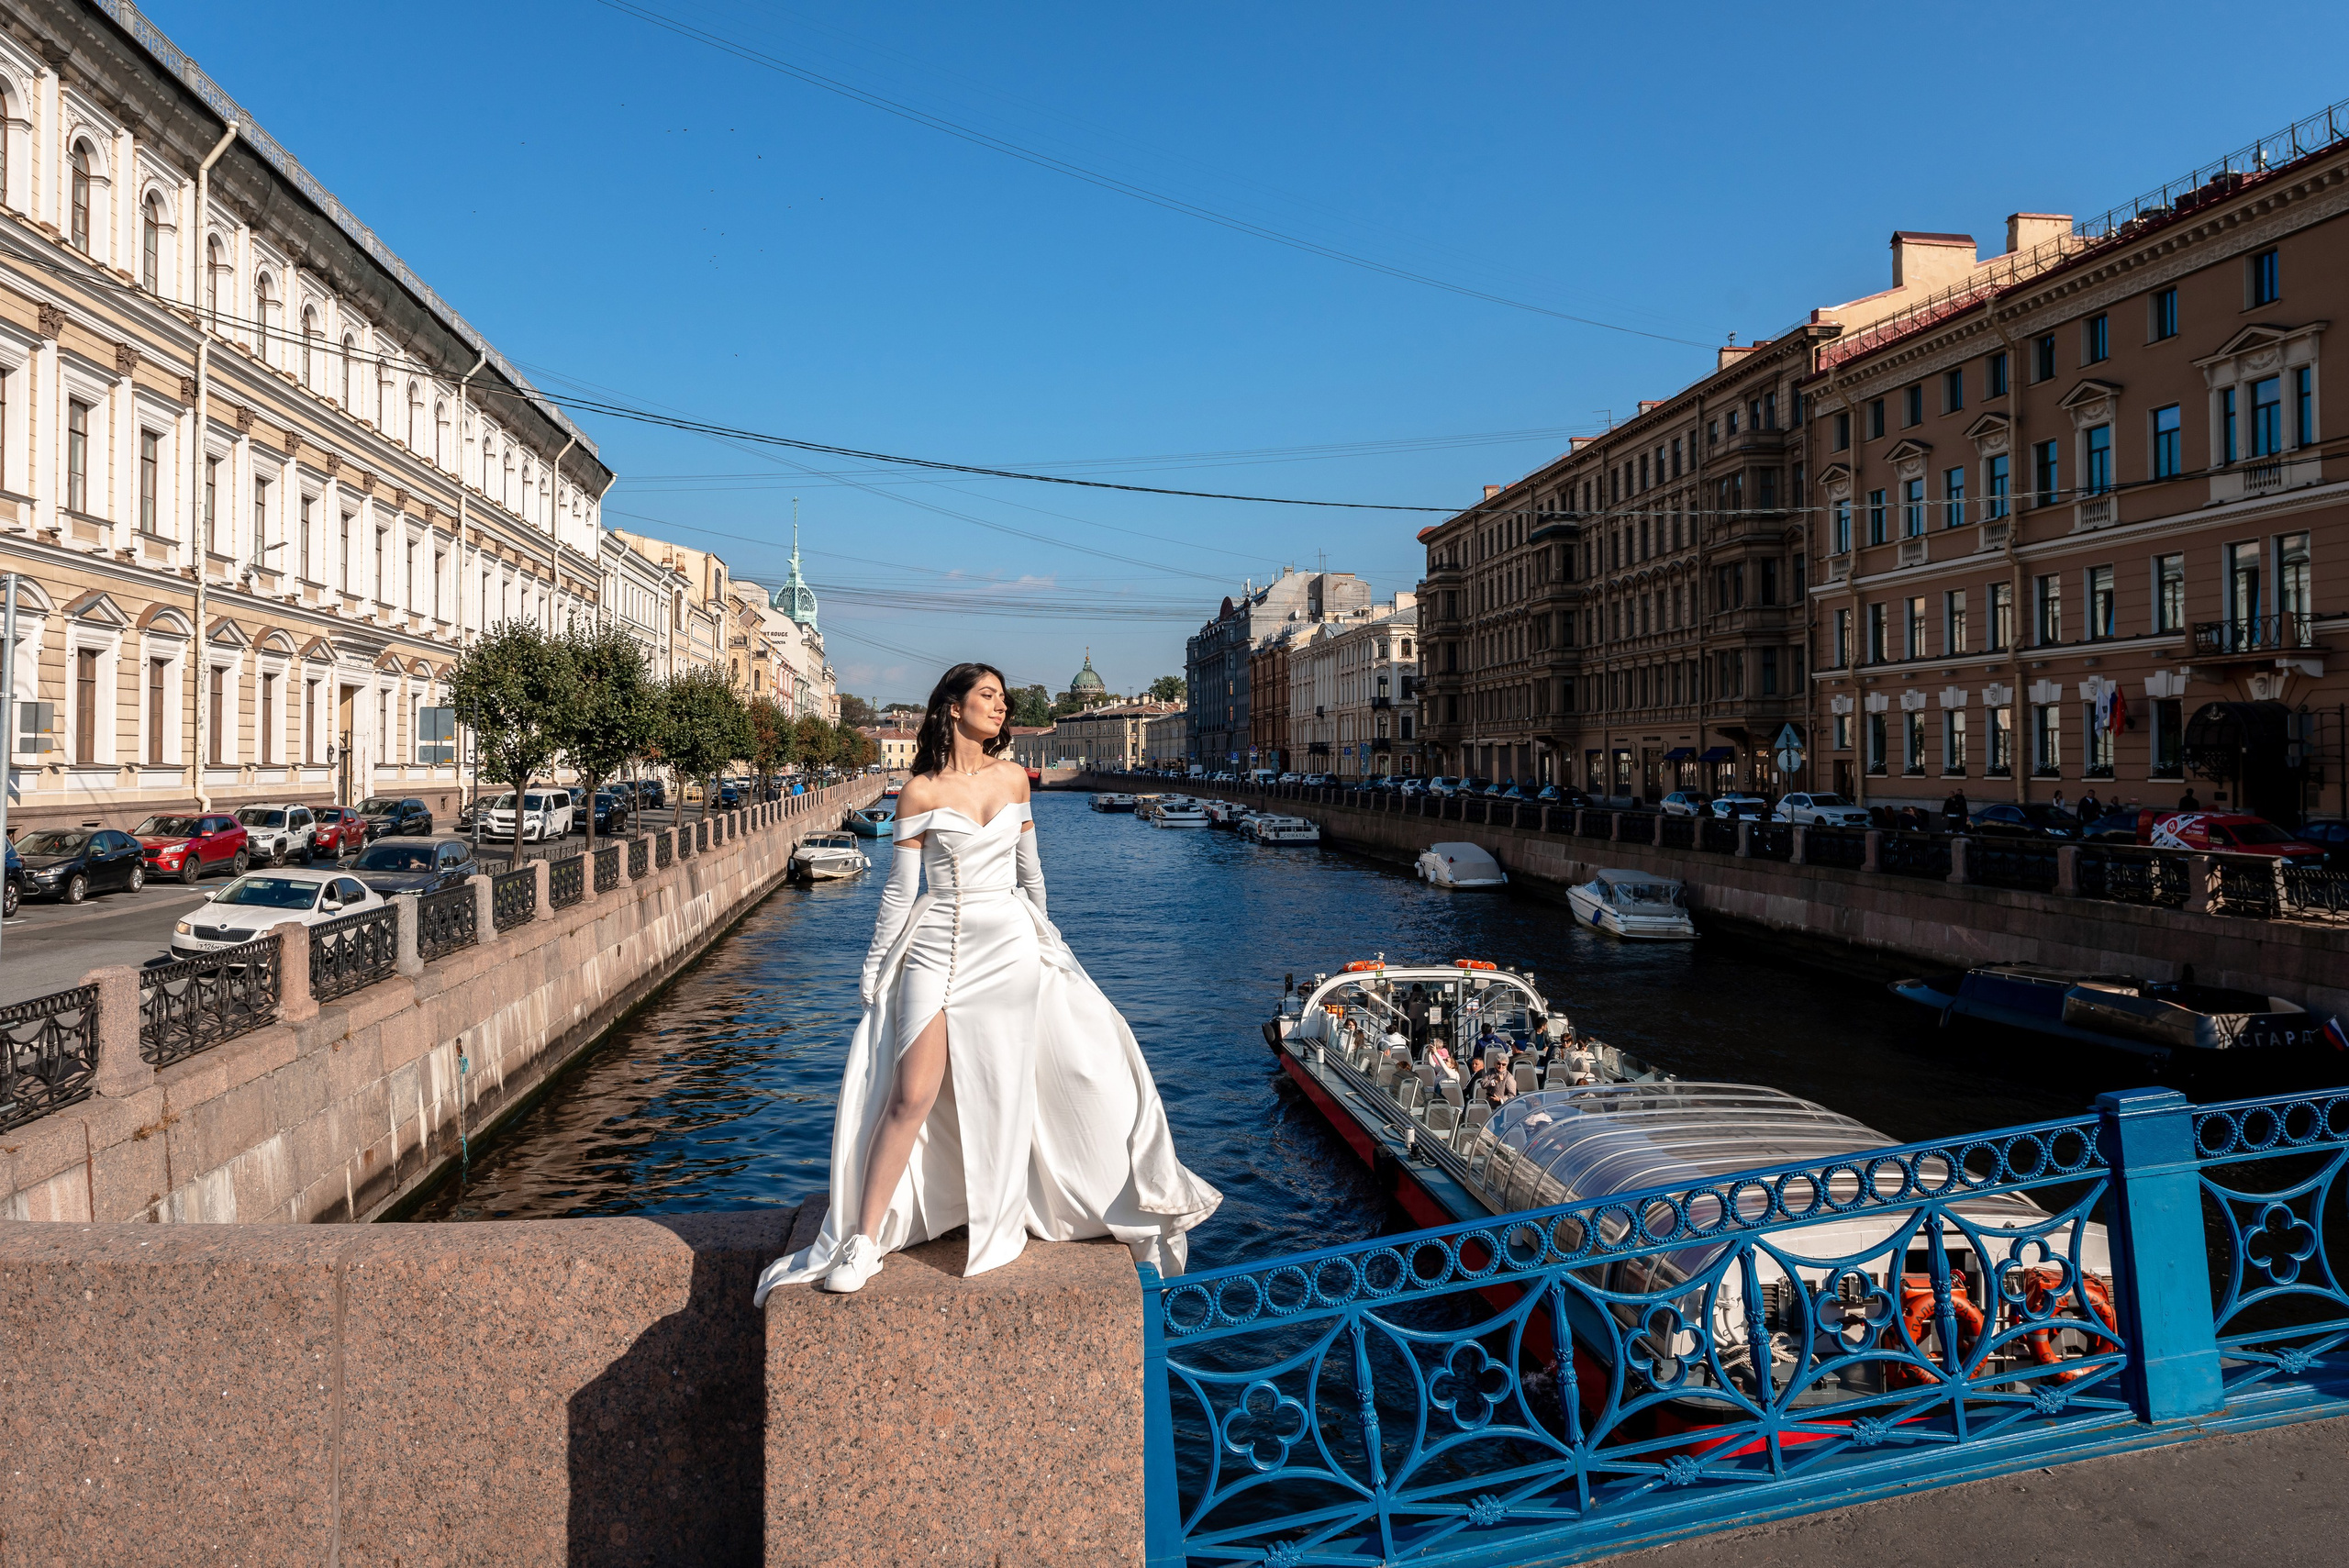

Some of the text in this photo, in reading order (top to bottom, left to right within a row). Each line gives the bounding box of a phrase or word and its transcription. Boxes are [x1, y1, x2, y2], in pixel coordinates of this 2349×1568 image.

[2168, 822, 2176, 832] Я
[2222, 1029, 2314, 1048] АСГАРД
[1910, 1300, 1979, 1332] ПАЛЬРА-2
